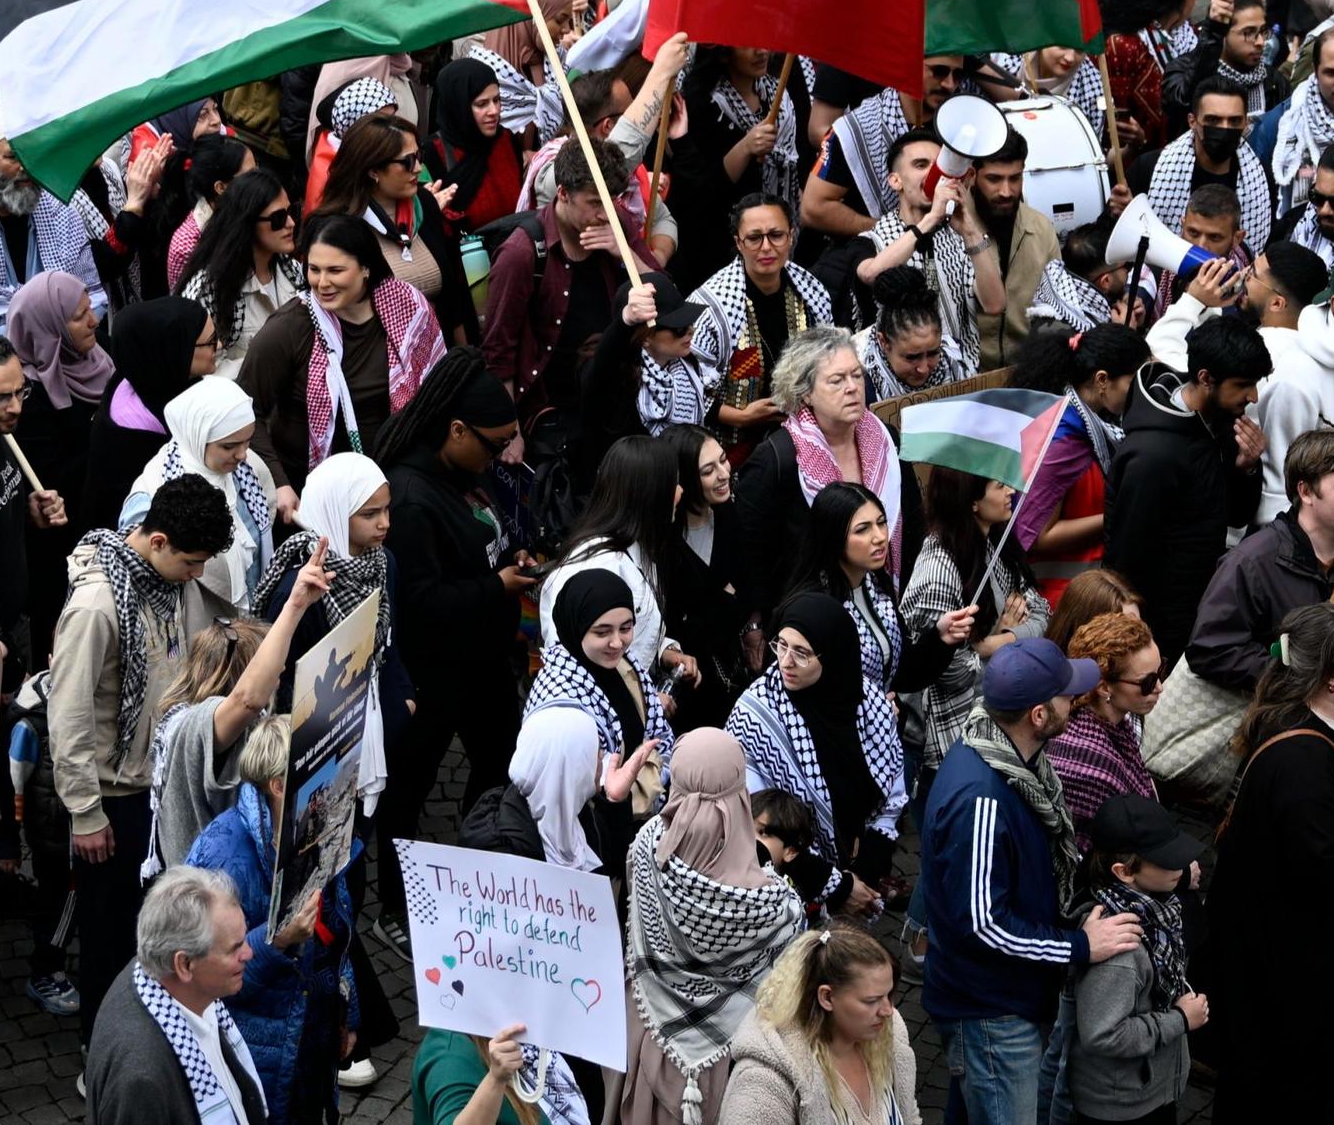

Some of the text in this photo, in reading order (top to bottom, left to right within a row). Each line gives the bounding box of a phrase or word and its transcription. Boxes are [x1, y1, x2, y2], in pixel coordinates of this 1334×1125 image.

[426, 863, 597, 923] The World has the
[459, 901, 583, 953] right to defend
[454, 930, 563, 984] Palestine
